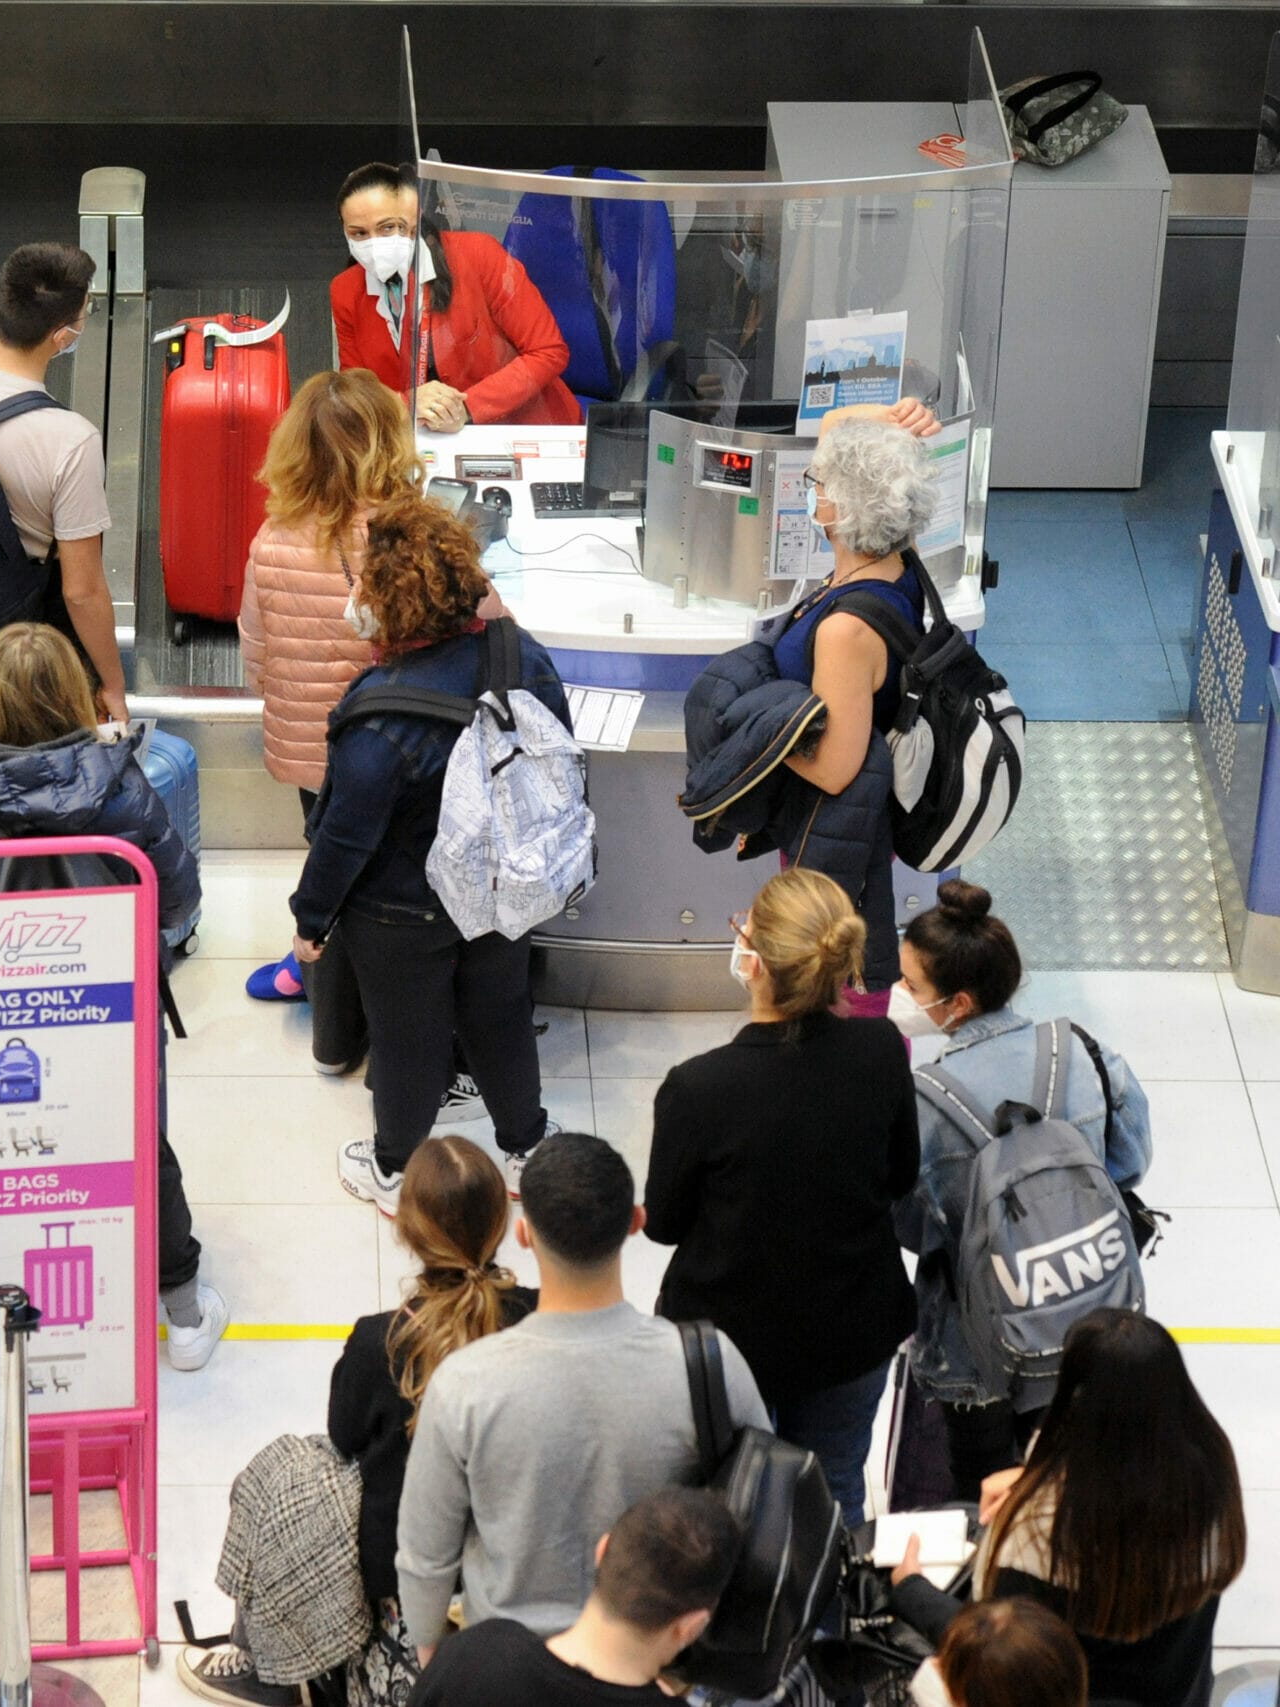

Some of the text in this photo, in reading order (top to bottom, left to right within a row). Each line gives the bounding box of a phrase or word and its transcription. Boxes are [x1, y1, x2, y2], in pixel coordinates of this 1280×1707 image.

[25, 988, 85, 1007] ONLY
[39, 1004, 111, 1023] Priority
[3, 1173, 60, 1191] BAGS
[342, 1178, 359, 1195] FILA
[21, 1188, 90, 1208] Priority
[112, 1216, 123, 1225] kg
[990, 1208, 1126, 1308] VANS
